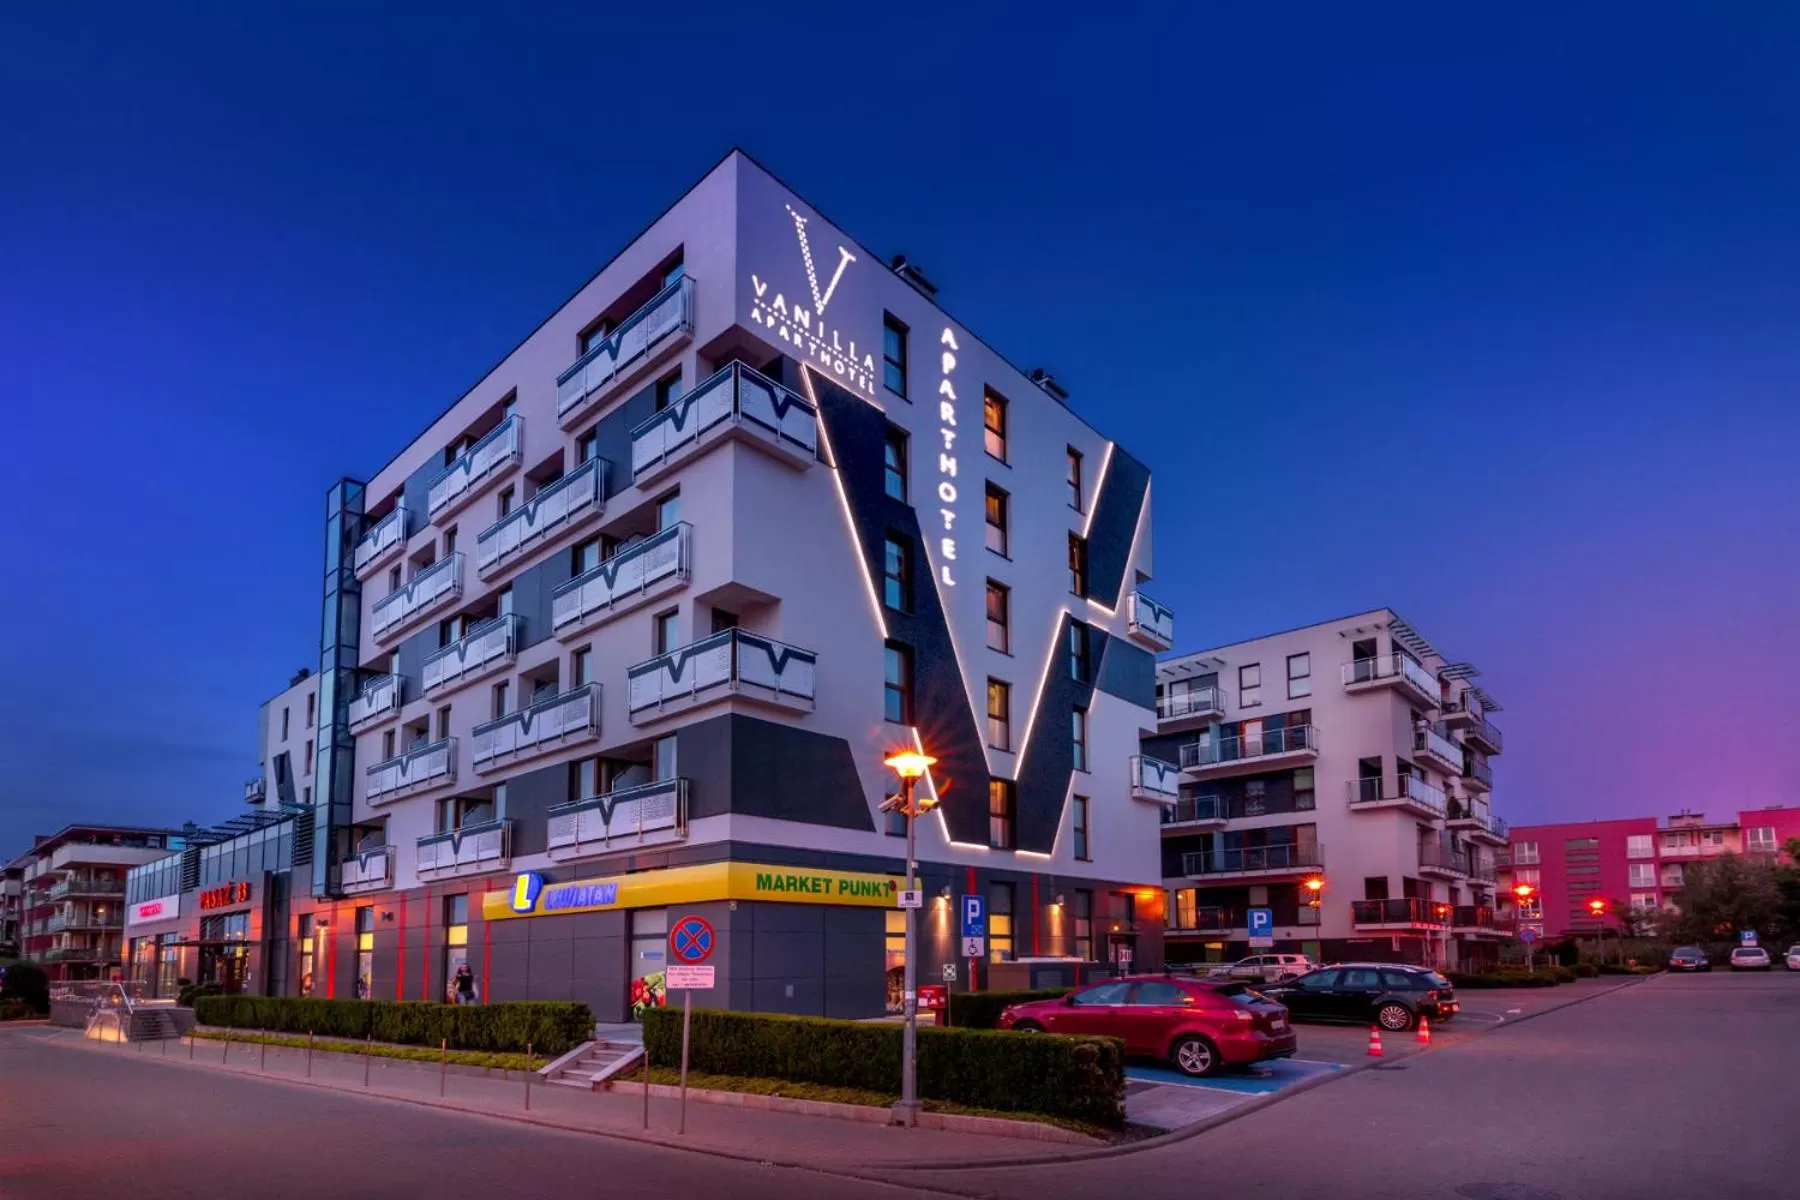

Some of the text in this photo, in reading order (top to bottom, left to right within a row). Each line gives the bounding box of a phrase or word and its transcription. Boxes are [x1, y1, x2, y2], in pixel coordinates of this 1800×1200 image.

[752, 274, 874, 372] VANILLA
[751, 308, 874, 395] APARTHOTEL
[938, 327, 958, 586] APARTHOTEL
[756, 872, 891, 898] MARKET PUNKT
[968, 899, 980, 925] P
[1253, 911, 1268, 929] P
